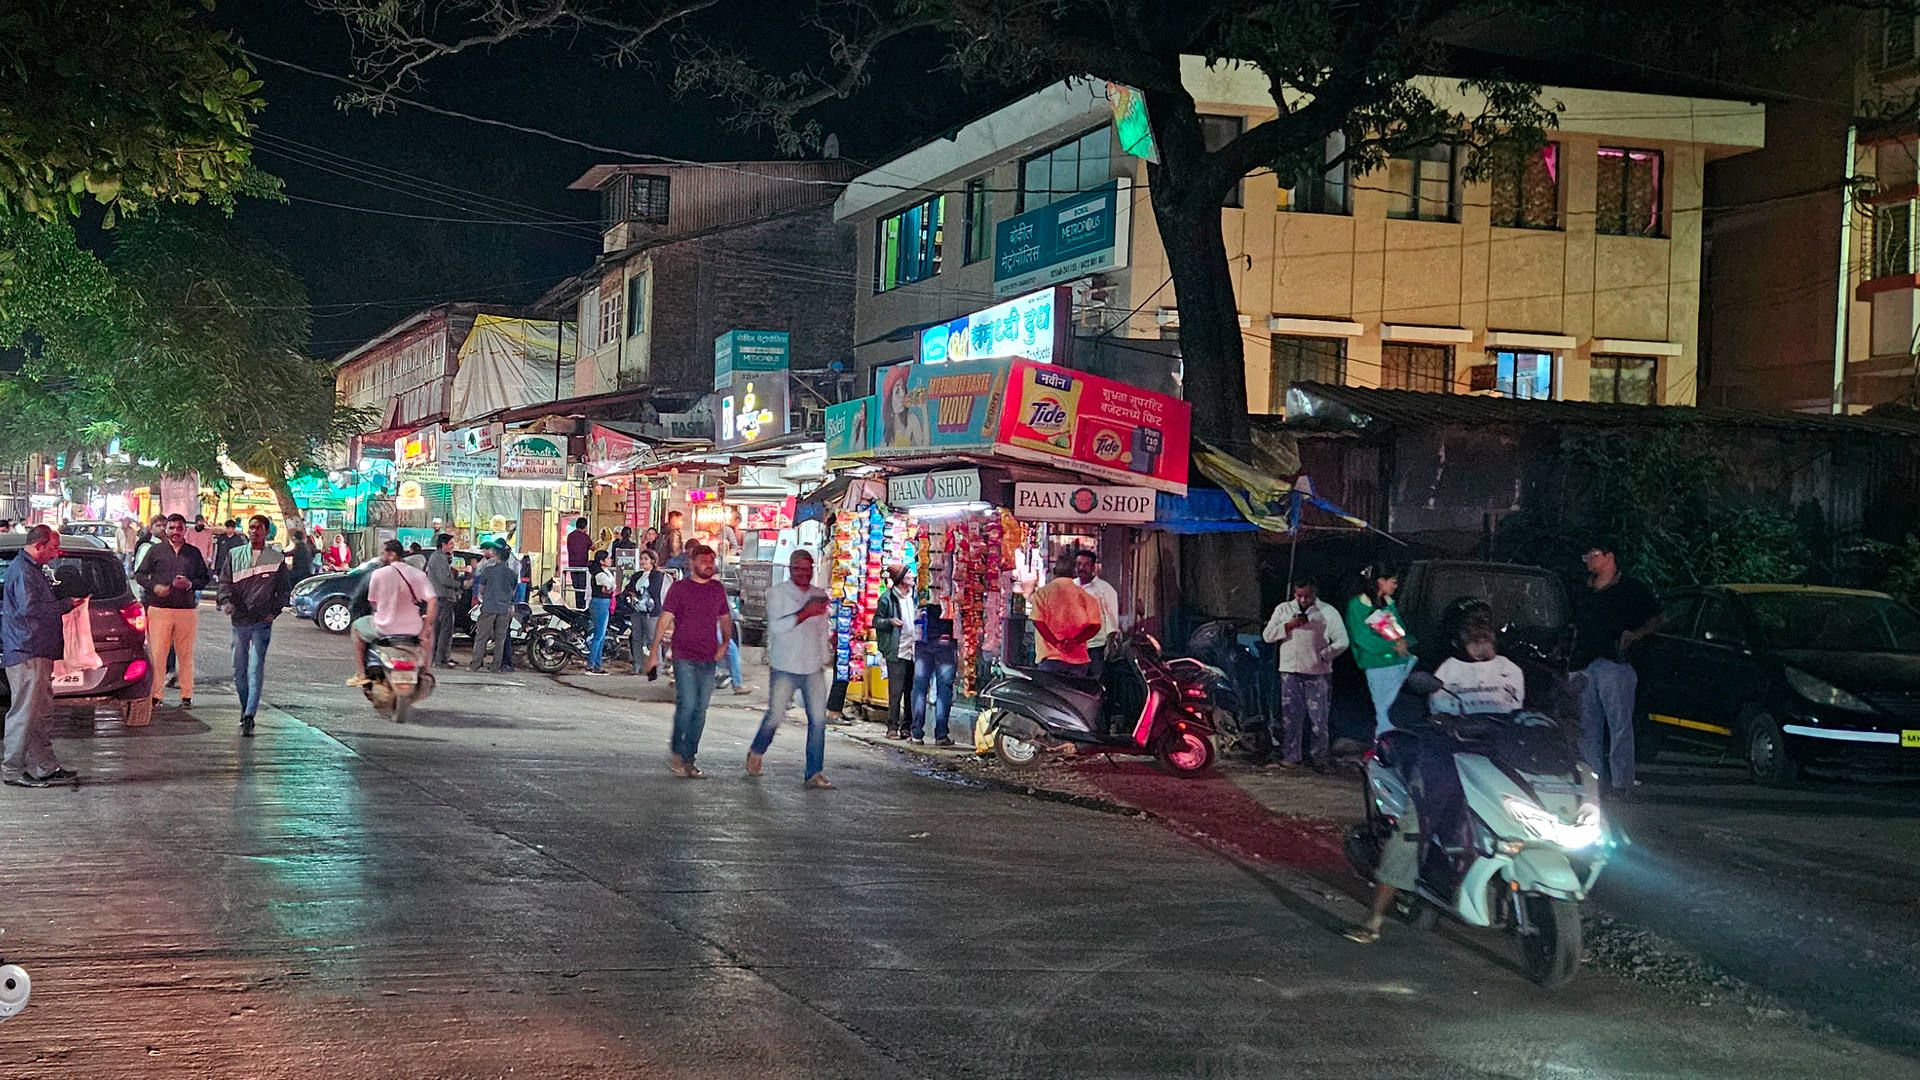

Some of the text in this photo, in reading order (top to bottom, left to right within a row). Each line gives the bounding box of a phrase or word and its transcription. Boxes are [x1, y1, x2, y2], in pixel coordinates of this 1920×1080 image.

[1061, 215, 1100, 239] METROPOLIS
[1041, 373, 1067, 389] नवीन
[938, 395, 974, 425] WOW
[1028, 401, 1066, 426] Tide
[1129, 392, 1164, 413] सुपरहिट
[1142, 409, 1163, 426] फिट
[1095, 438, 1119, 454] Tide
[538, 467, 564, 475] HOUSE
[892, 476, 972, 502] PAAN SHOP
[1019, 490, 1151, 514] PAAN SHOP
